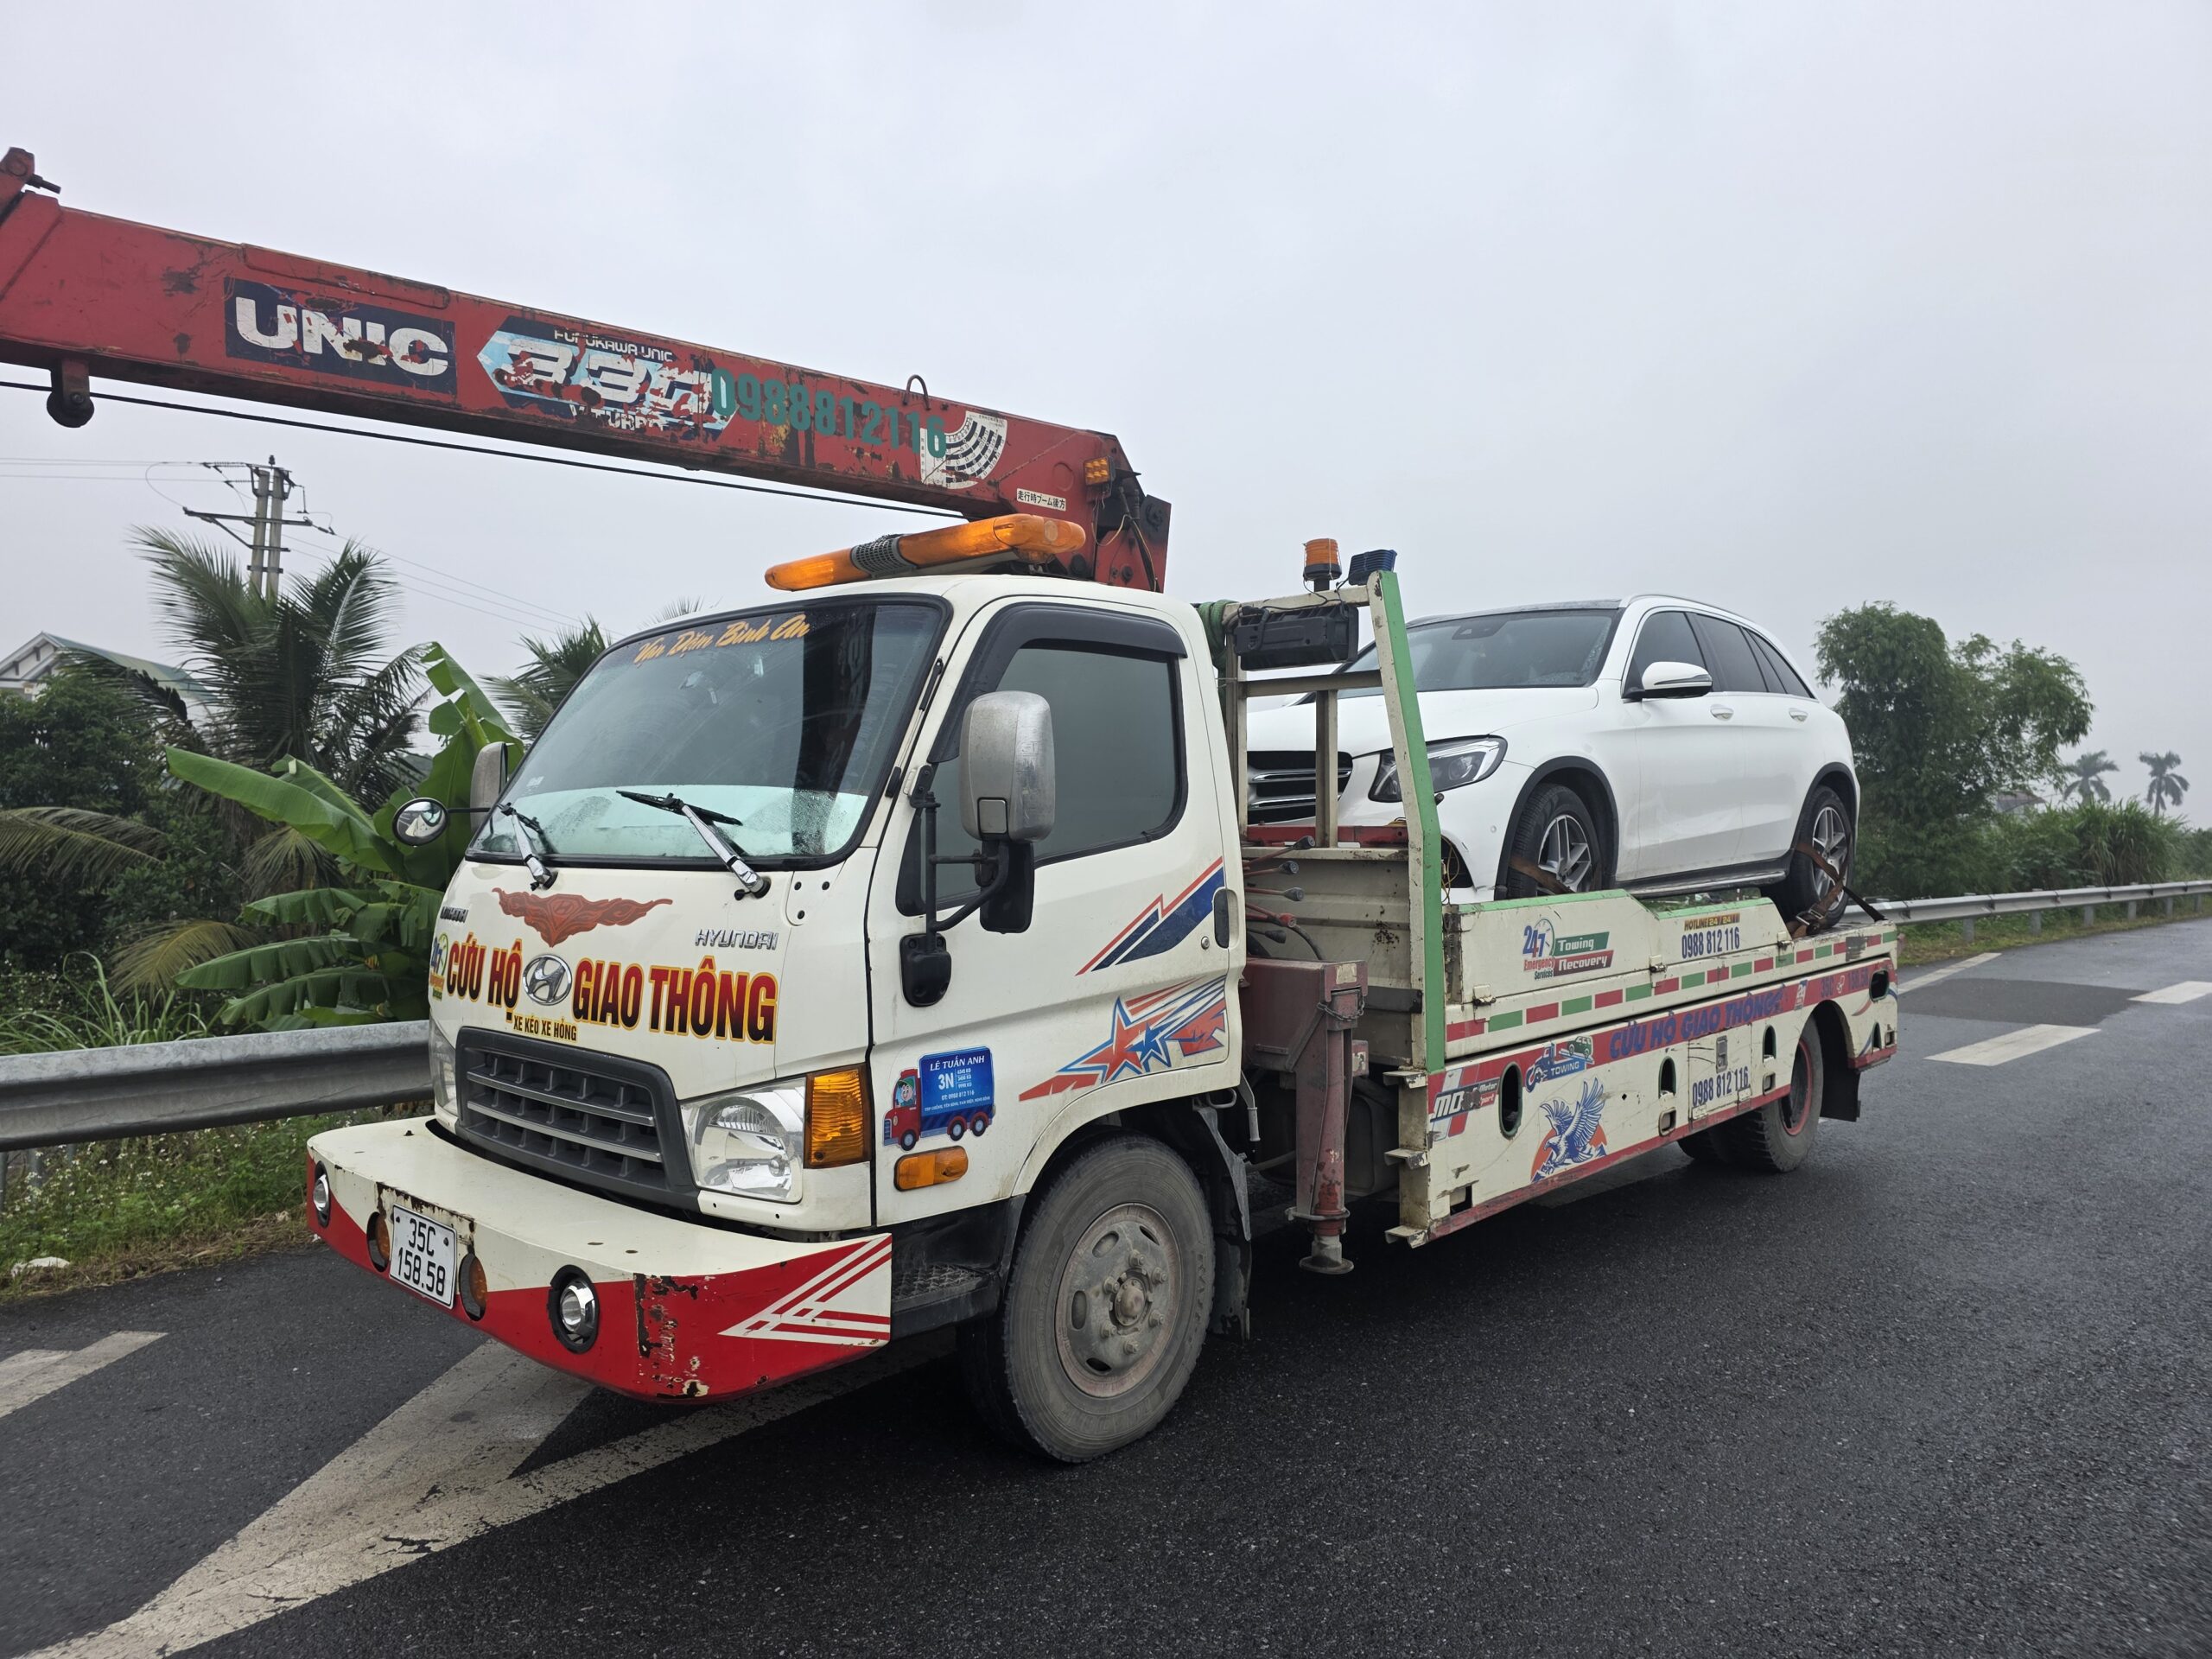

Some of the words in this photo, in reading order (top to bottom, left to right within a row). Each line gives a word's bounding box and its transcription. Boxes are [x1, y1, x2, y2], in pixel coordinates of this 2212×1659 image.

[236, 296, 448, 376] UNIC
[640, 346, 674, 363] UNIC
[711, 368, 947, 459] 0988812116
[1018, 490, 1065, 509] 走行時ブーム後方
[715, 619, 772, 647] Bình
[695, 928, 779, 950] HYUNDAI
[1558, 938, 1594, 951] Towing
[1682, 931, 1704, 959] 0988
[1707, 929, 1722, 954] 812
[1725, 926, 1739, 950] 116
[1523, 957, 1555, 971] Emergency
[1535, 969, 1554, 980] Services
[1558, 956, 1608, 971] Recovery
[447, 931, 486, 1002] CỨU
[486, 938, 523, 1023] HỘ
[572, 957, 645, 1031] GIAO
[648, 955, 779, 1045] THÔNG
[513, 1014, 524, 1032] XE
[524, 1014, 539, 1035] KÉO
[541, 1020, 552, 1037] XE
[553, 1016, 577, 1041] HỎNG
[1680, 1006, 1721, 1039] GIAO
[930, 1061, 941, 1071] LÊ
[942, 1055, 966, 1070] TUẤN
[967, 1055, 985, 1065] ANH
[1550, 1060, 1580, 1077] TOWING
[938, 1071, 955, 1090] 3N
[1479, 1082, 1497, 1092] Motor
[1693, 1077, 1713, 1107] 0988
[1717, 1071, 1732, 1098] 812
[1734, 1065, 1748, 1090] 116
[409, 1217, 435, 1257] 35C
[398, 1247, 446, 1297] 158.58
